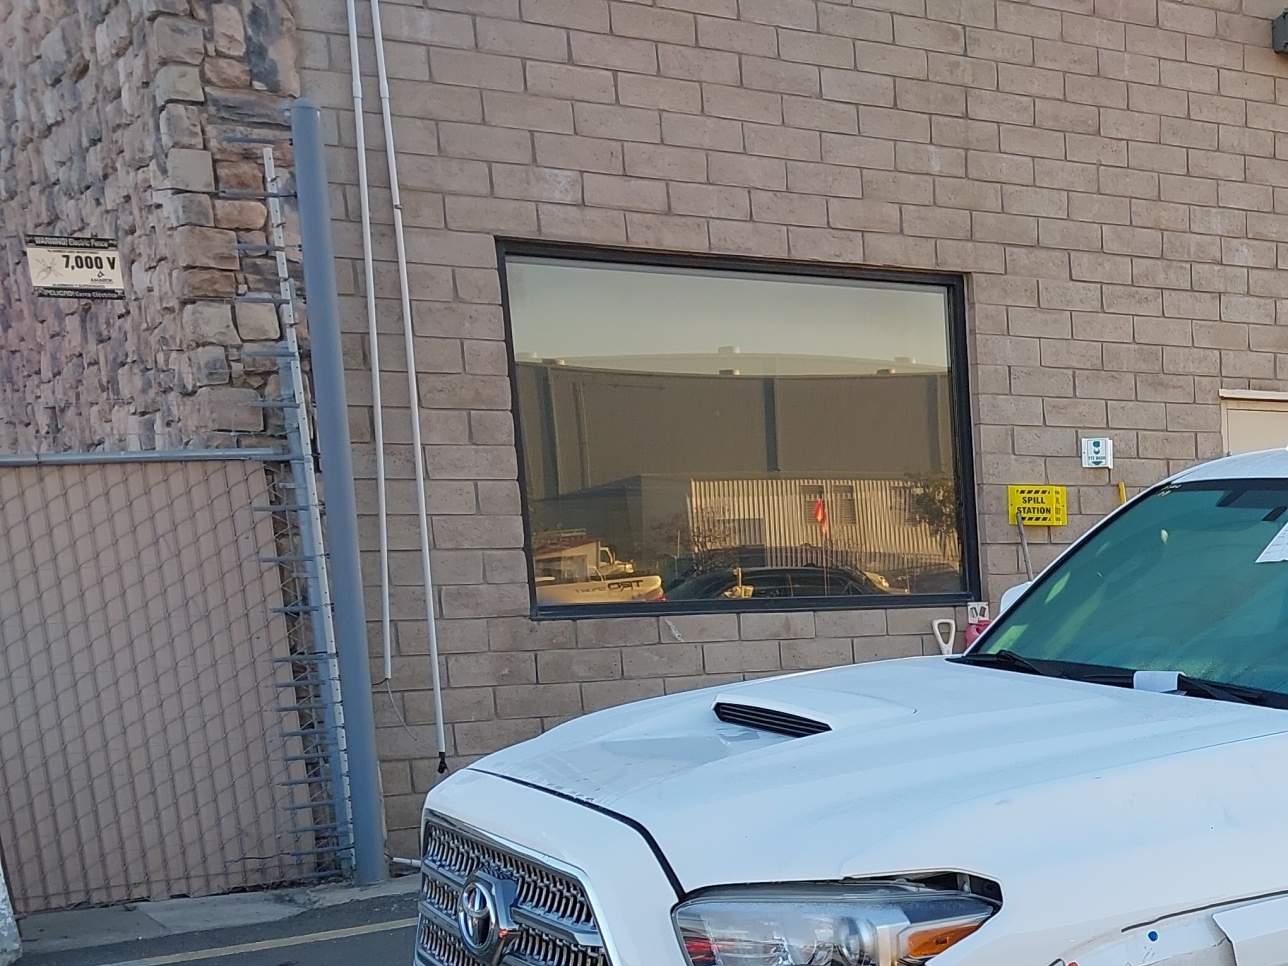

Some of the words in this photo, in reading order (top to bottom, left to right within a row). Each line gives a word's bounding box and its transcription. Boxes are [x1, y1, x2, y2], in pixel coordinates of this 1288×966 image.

[62, 254, 104, 270] 7,000
[106, 256, 116, 270] V
[1022, 496, 1045, 505] SPILL
[1016, 506, 1051, 515] STATION
